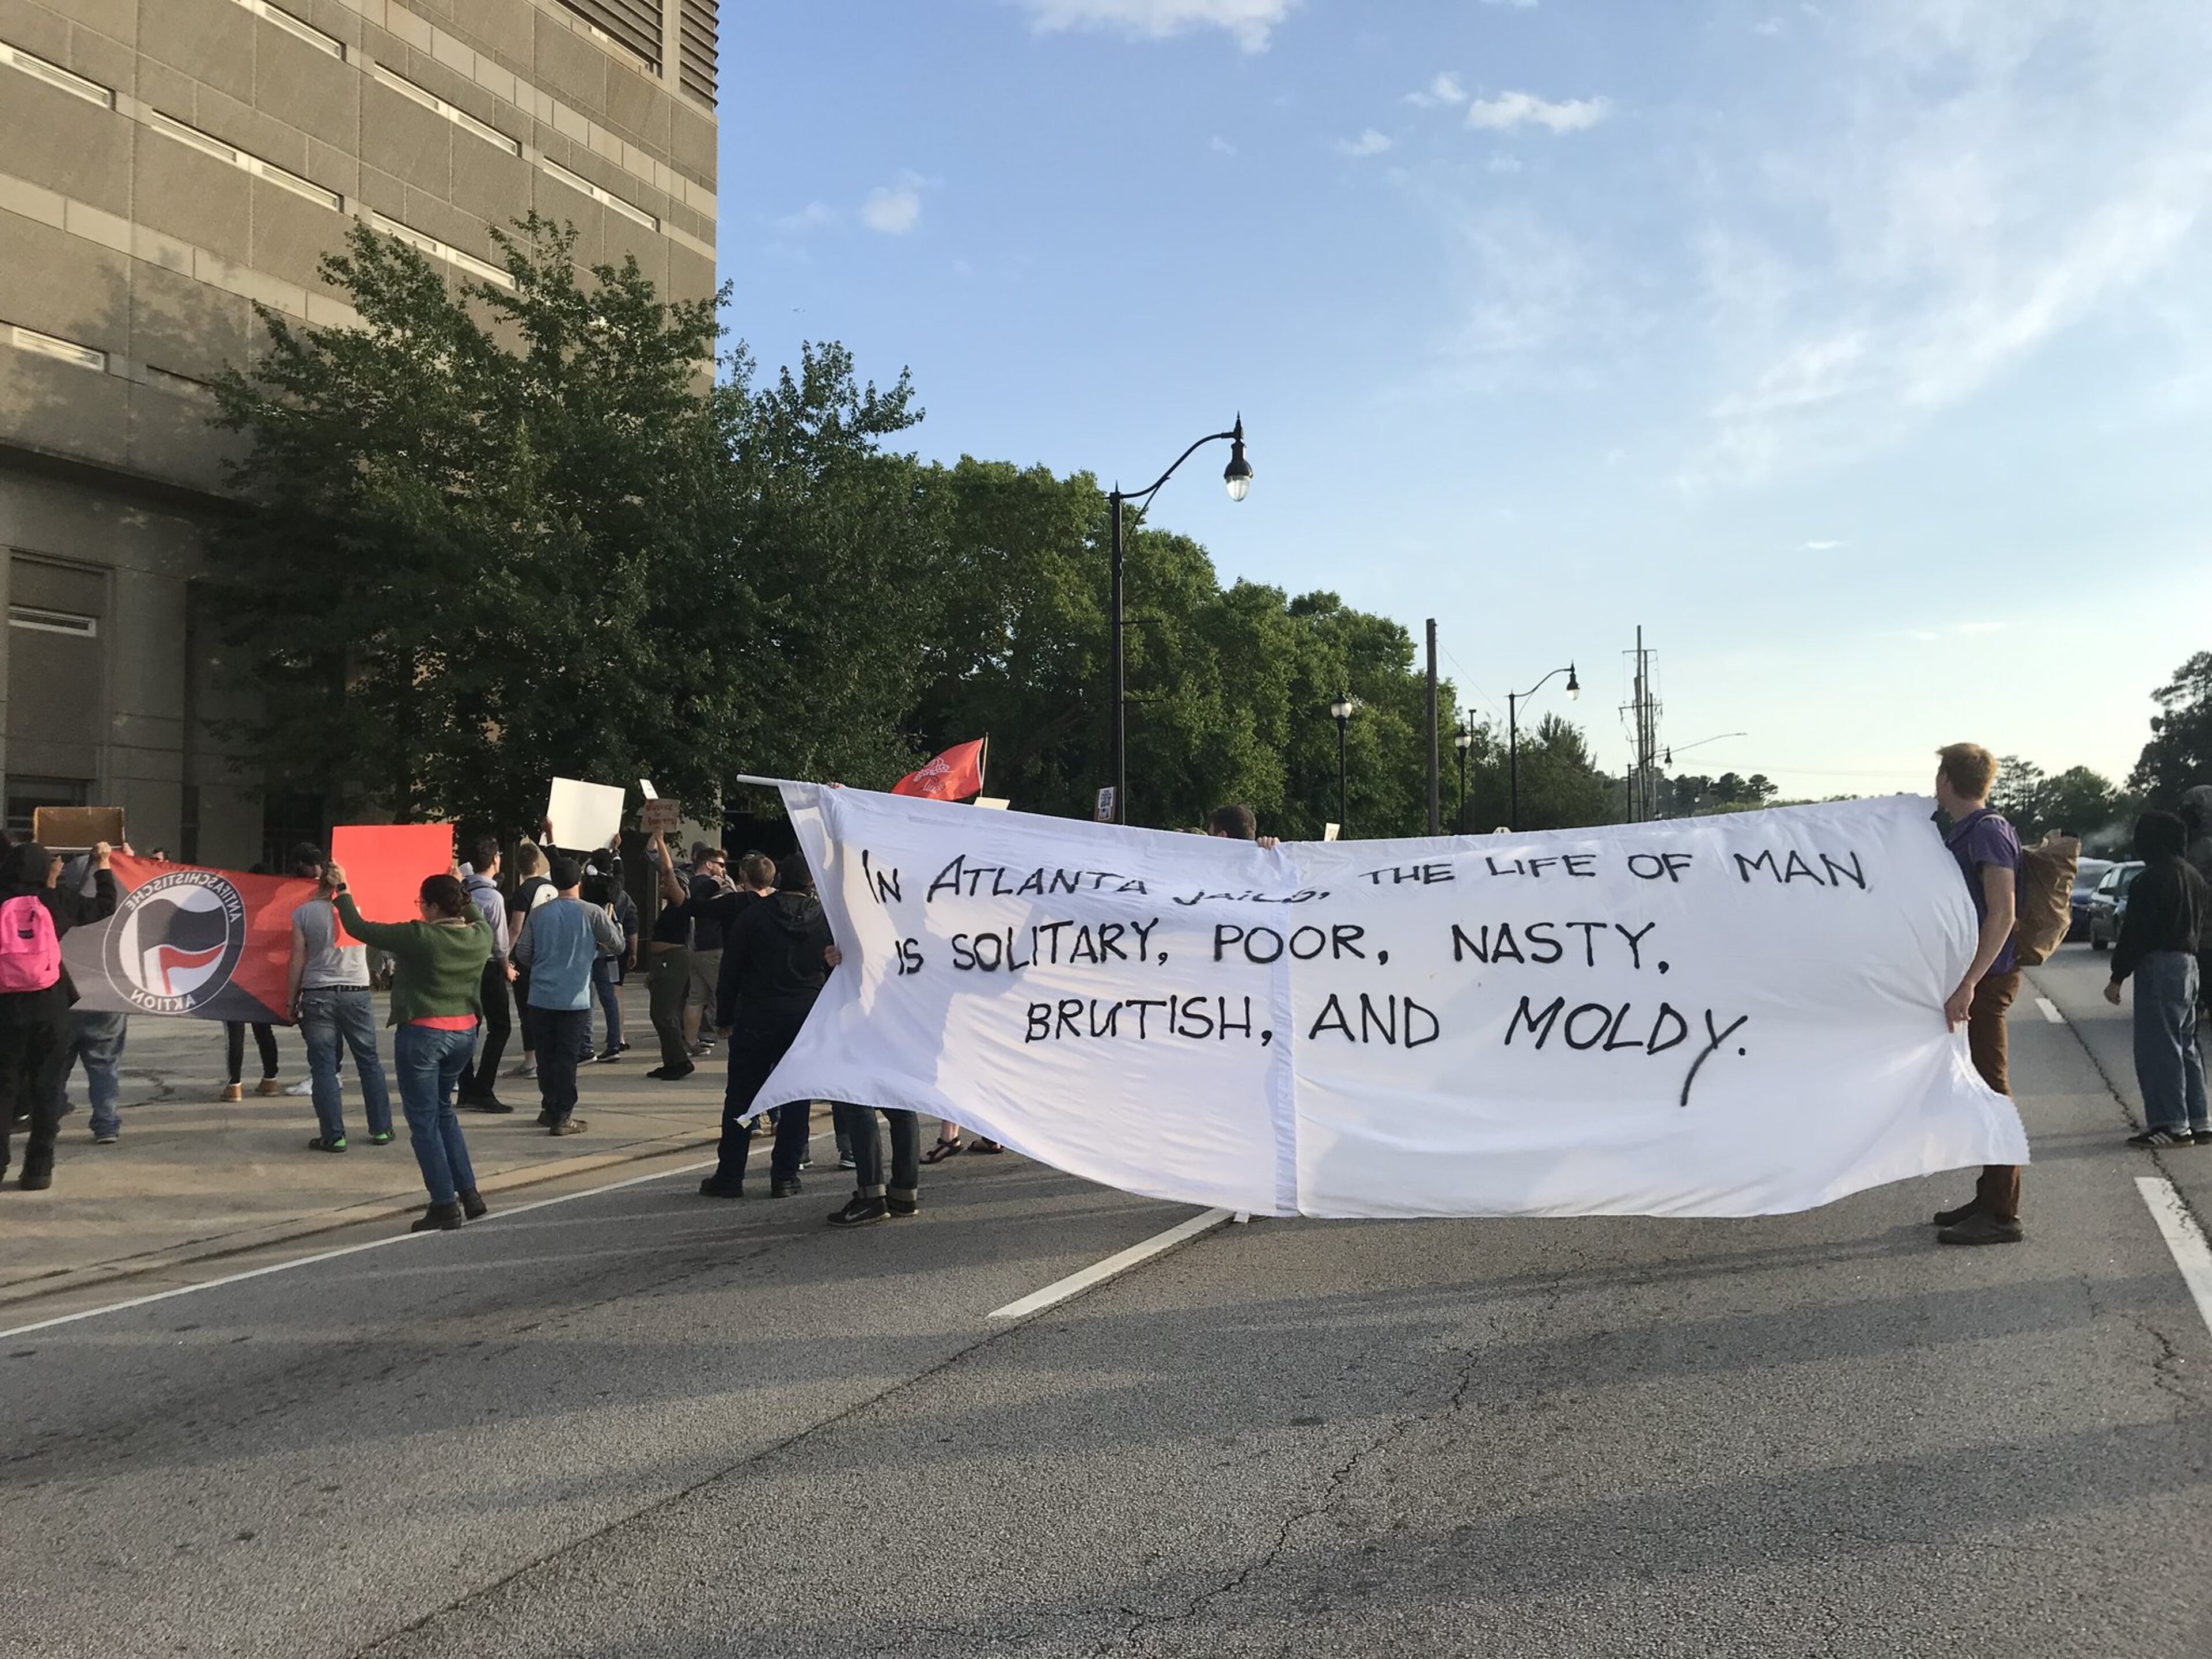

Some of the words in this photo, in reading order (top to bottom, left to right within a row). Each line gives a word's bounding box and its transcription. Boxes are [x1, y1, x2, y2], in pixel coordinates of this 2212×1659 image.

[861, 849, 902, 904] IN
[926, 854, 1149, 904] ATLANTA
[1359, 863, 1456, 885] THE
[1484, 854, 1597, 878] LIFE
[1627, 853, 1693, 883] OF
[1733, 849, 1866, 890] MAN
[895, 937, 925, 976] IS
[951, 917, 1168, 974] SOLITARY,
[1213, 923, 1389, 966] POOR,
[1451, 921, 1670, 975] NASTY,
[1024, 994, 1273, 1047] BRUTISH,
[1308, 993, 1440, 1050] AND
[1504, 995, 1749, 1108] MOLDY.
